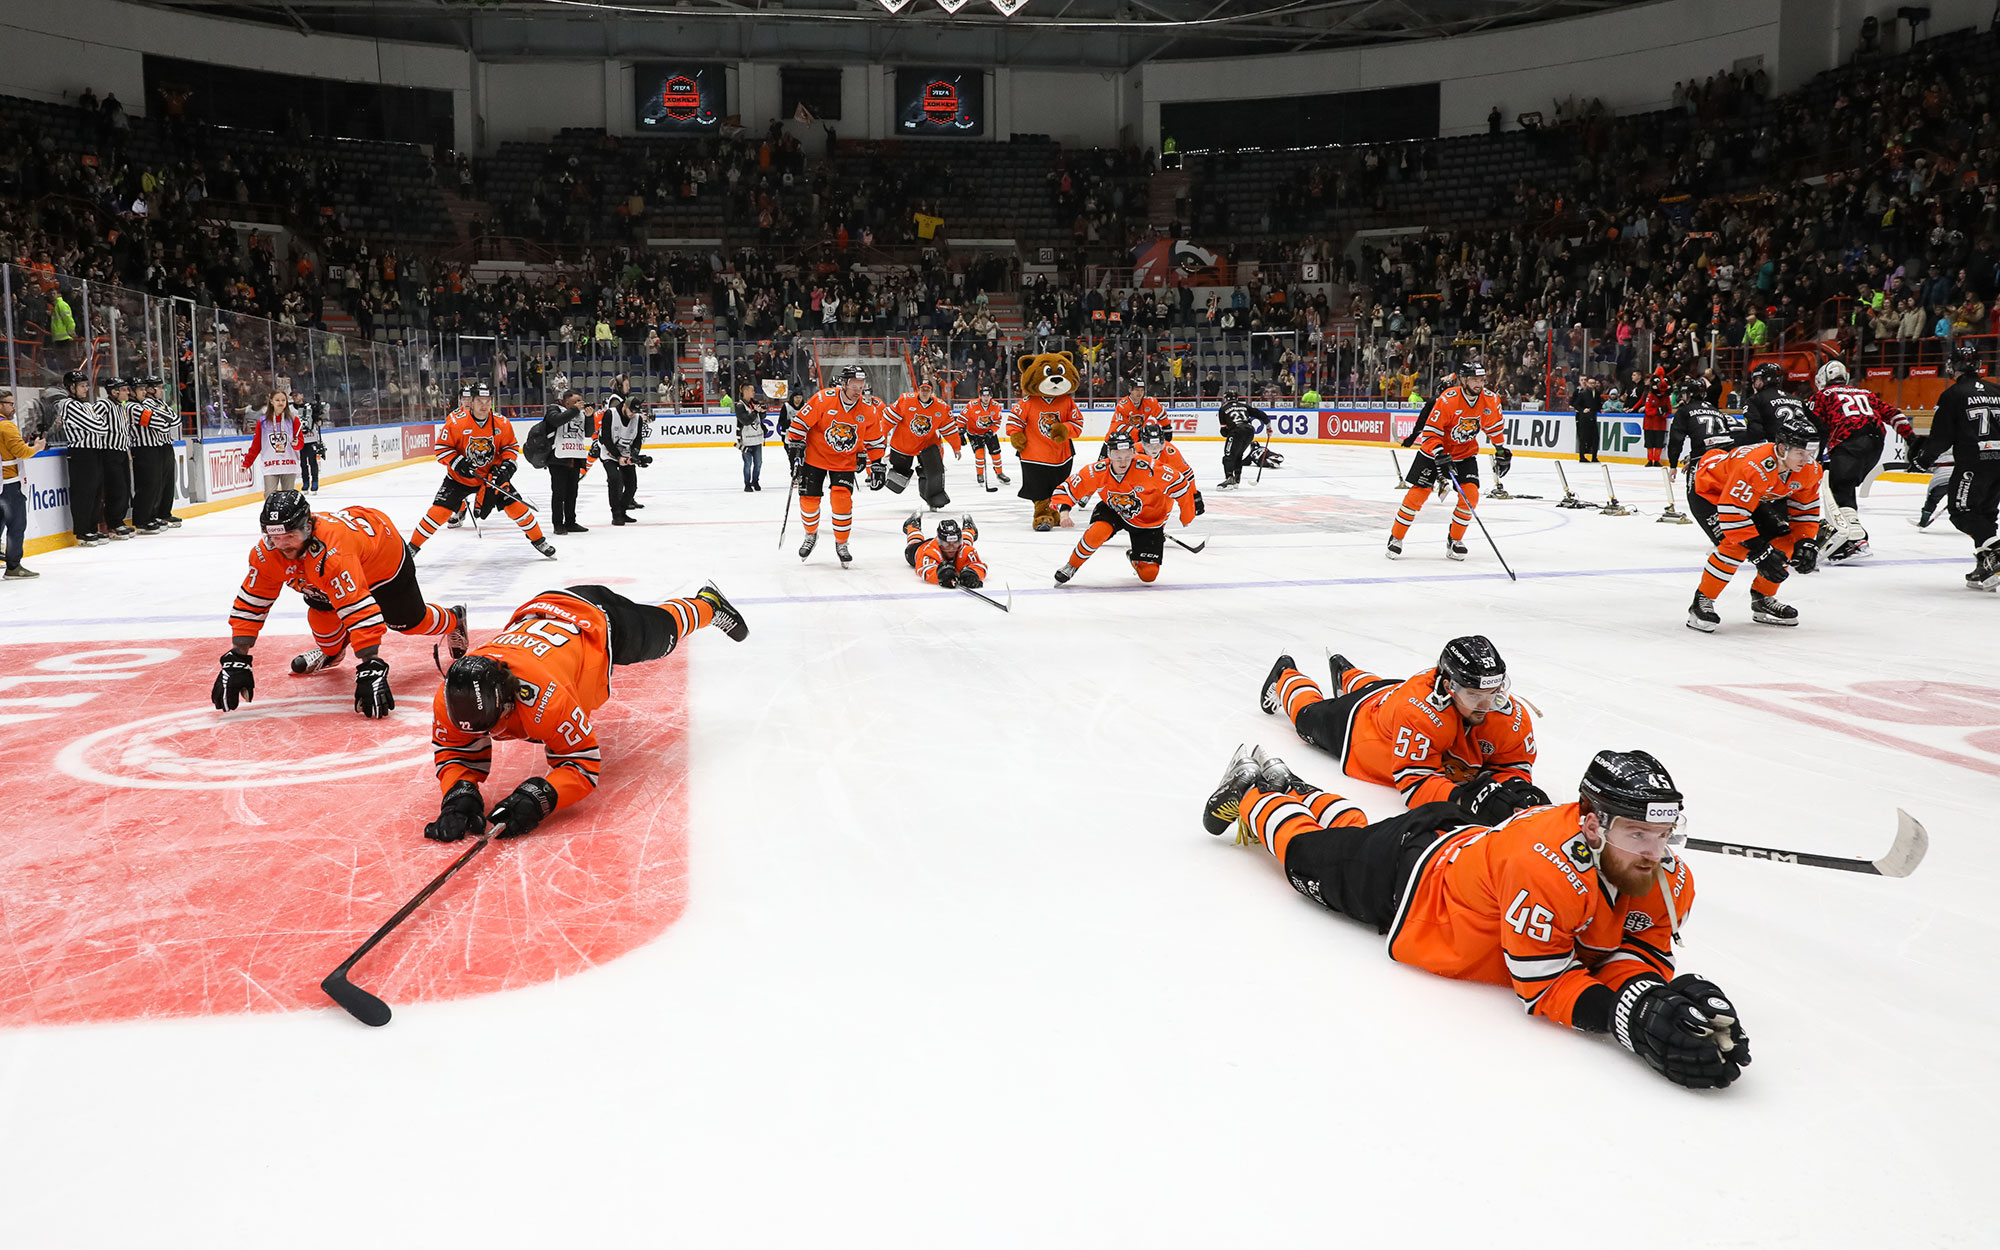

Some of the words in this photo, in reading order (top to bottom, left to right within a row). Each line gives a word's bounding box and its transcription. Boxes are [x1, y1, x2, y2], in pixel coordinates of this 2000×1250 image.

[1837, 393, 1875, 417] 20
[661, 424, 732, 436] HCAMUR.RU
[1341, 419, 1385, 434] OLIMPBET
[1486, 418, 1561, 448] HL.RU
[209, 454, 233, 489] World
[264, 459, 279, 467] SAFE
[1729, 479, 1755, 503] 25
[269, 511, 279, 521] 33
[1752, 544, 1774, 566] CCM
[329, 569, 357, 600] 33
[1450, 644, 1470, 667] OLIMPBET
[1480, 656, 1497, 669] 53
[472, 680, 484, 711] OLIMPBET
[533, 680, 558, 724] OLIMPBET
[1407, 696, 1444, 730] OLIMPBET
[459, 720, 473, 731] 22
[556, 705, 594, 747] 22
[1393, 725, 1432, 762] 53
[1594, 755, 1623, 777] OLIMPBET
[1647, 772, 1672, 790] 45
[1470, 781, 1503, 815] CCM
[1721, 845, 1799, 865] CCM
[1532, 841, 1590, 897] OLIMPBET
[1503, 887, 1555, 943] 45
